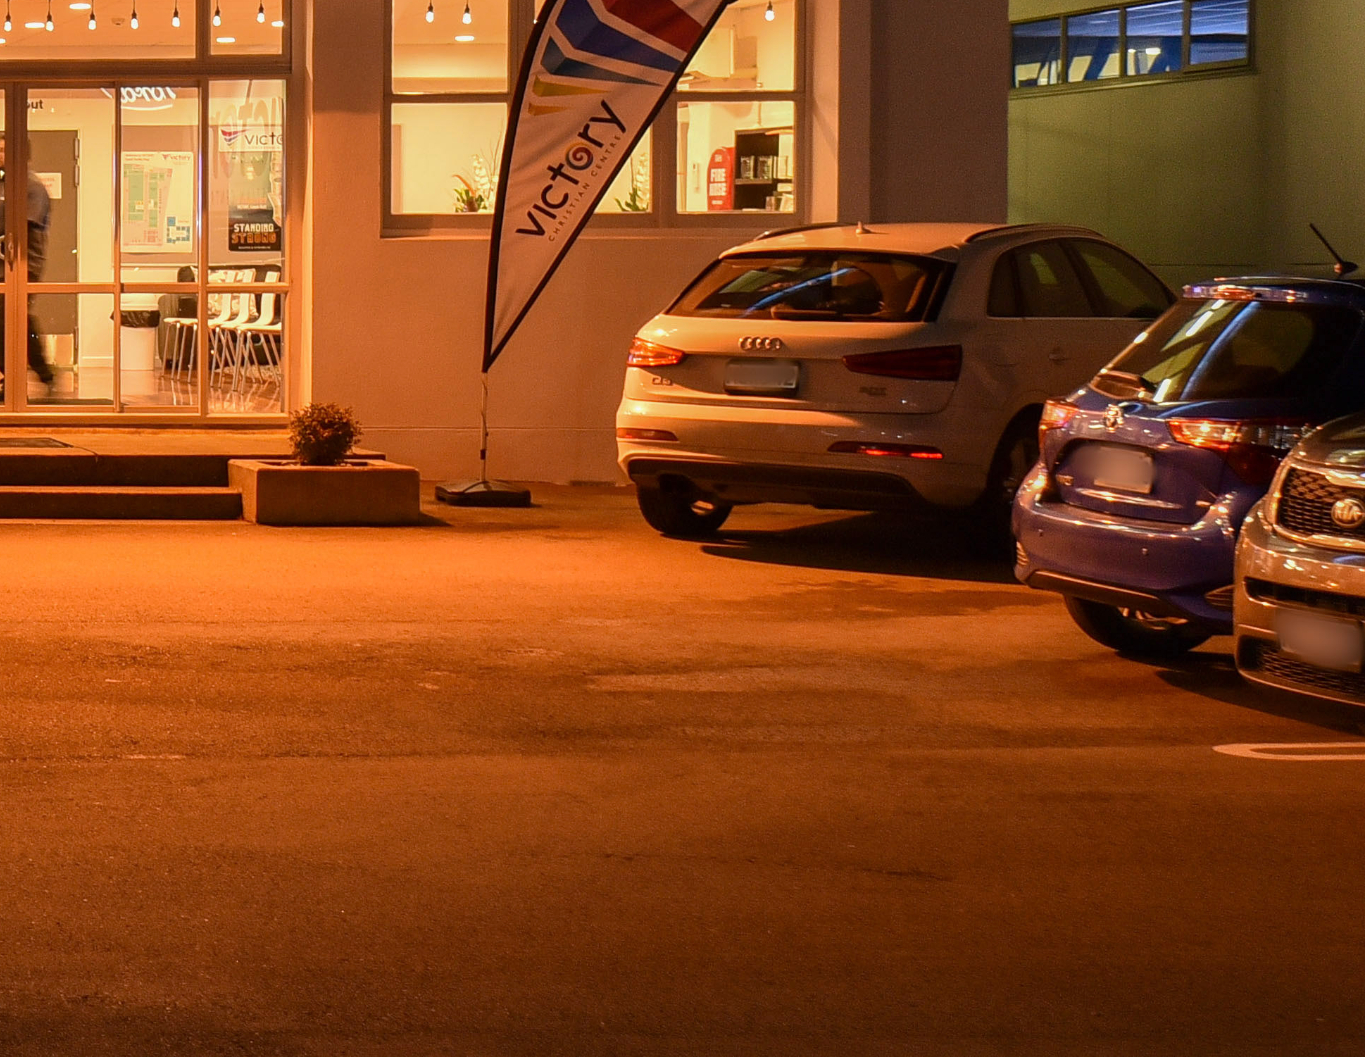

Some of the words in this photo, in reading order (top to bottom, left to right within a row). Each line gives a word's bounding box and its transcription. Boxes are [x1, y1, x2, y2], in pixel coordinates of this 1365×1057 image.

[710, 168, 726, 182] FIRE
[548, 183, 590, 242] CHRISTIAN
[590, 134, 622, 177] CENTRE
[233, 223, 275, 233] STANDING
[231, 232, 277, 244] STRONG
